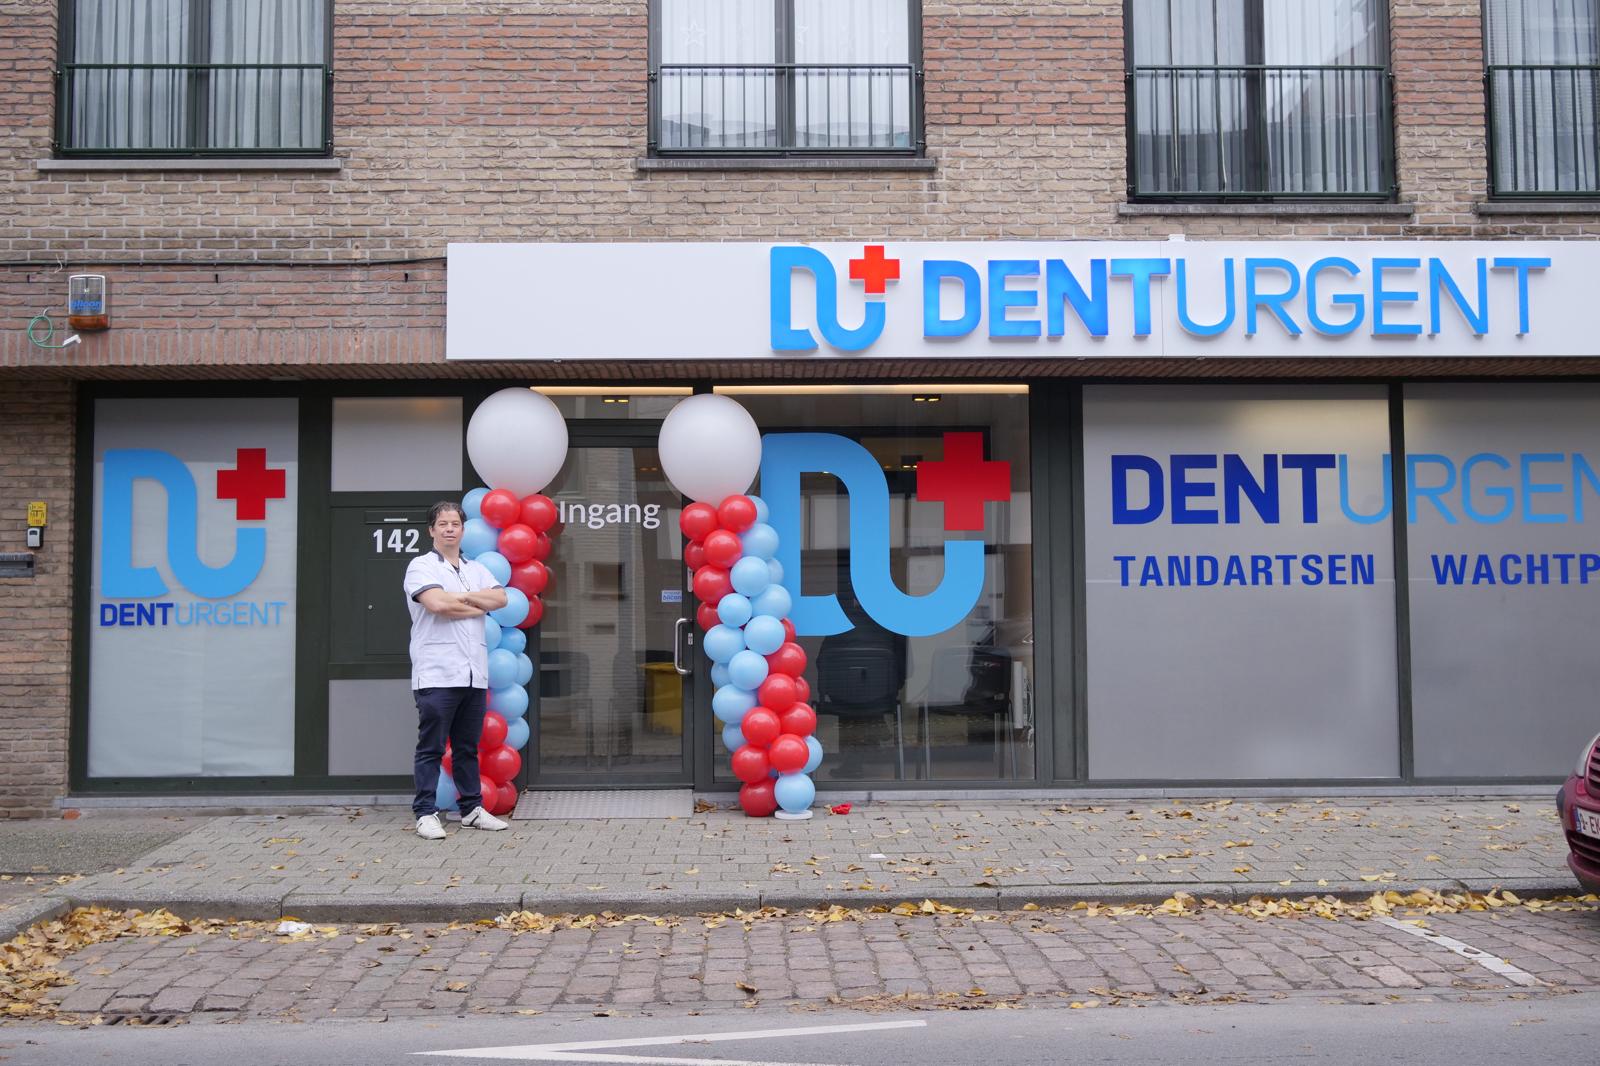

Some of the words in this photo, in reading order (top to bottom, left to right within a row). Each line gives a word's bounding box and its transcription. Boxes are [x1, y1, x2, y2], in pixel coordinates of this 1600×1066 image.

[923, 256, 1552, 338] DENTURGENT
[559, 500, 661, 530] Ingang
[372, 528, 420, 553] 142
[1113, 554, 1375, 587] TANDARTSEN
[1430, 553, 1600, 586] WACHTP
[99, 601, 288, 627] DENTURGENT
